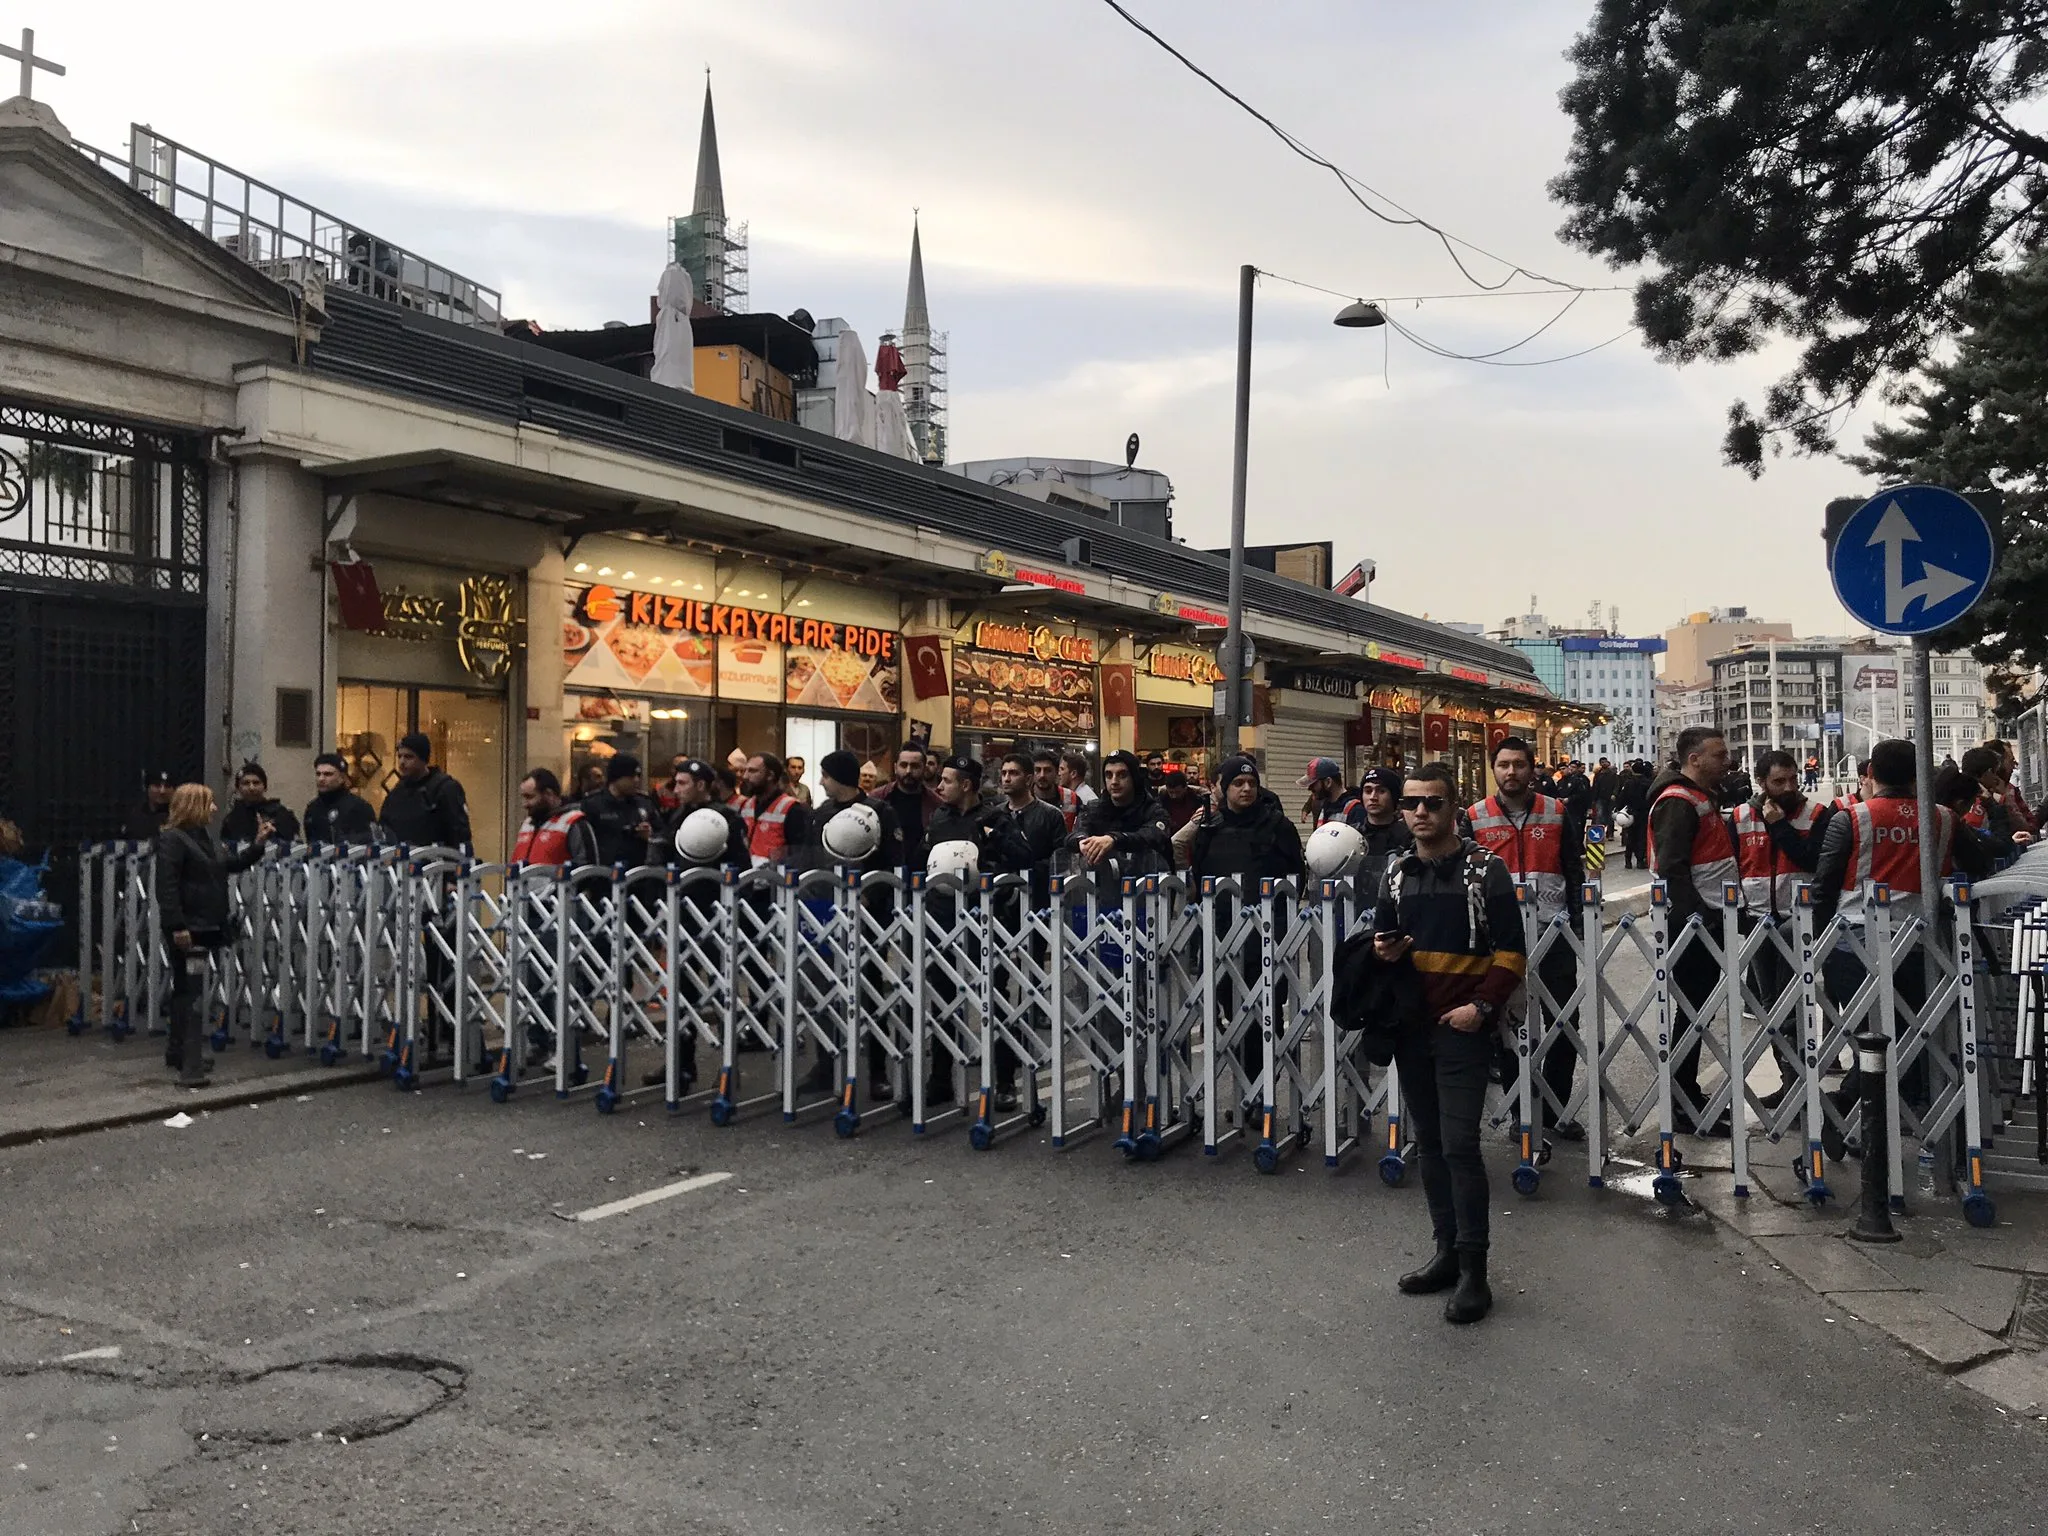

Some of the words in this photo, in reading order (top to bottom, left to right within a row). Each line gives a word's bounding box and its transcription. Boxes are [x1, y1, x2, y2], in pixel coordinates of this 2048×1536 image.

[631, 591, 836, 650] KIZILKAYALAR
[1324, 676, 1351, 696] GOLD
[1655, 947, 1668, 1046] POLİS
[1803, 949, 1817, 1051] POLİS
[1961, 951, 1975, 1056] POLİS
